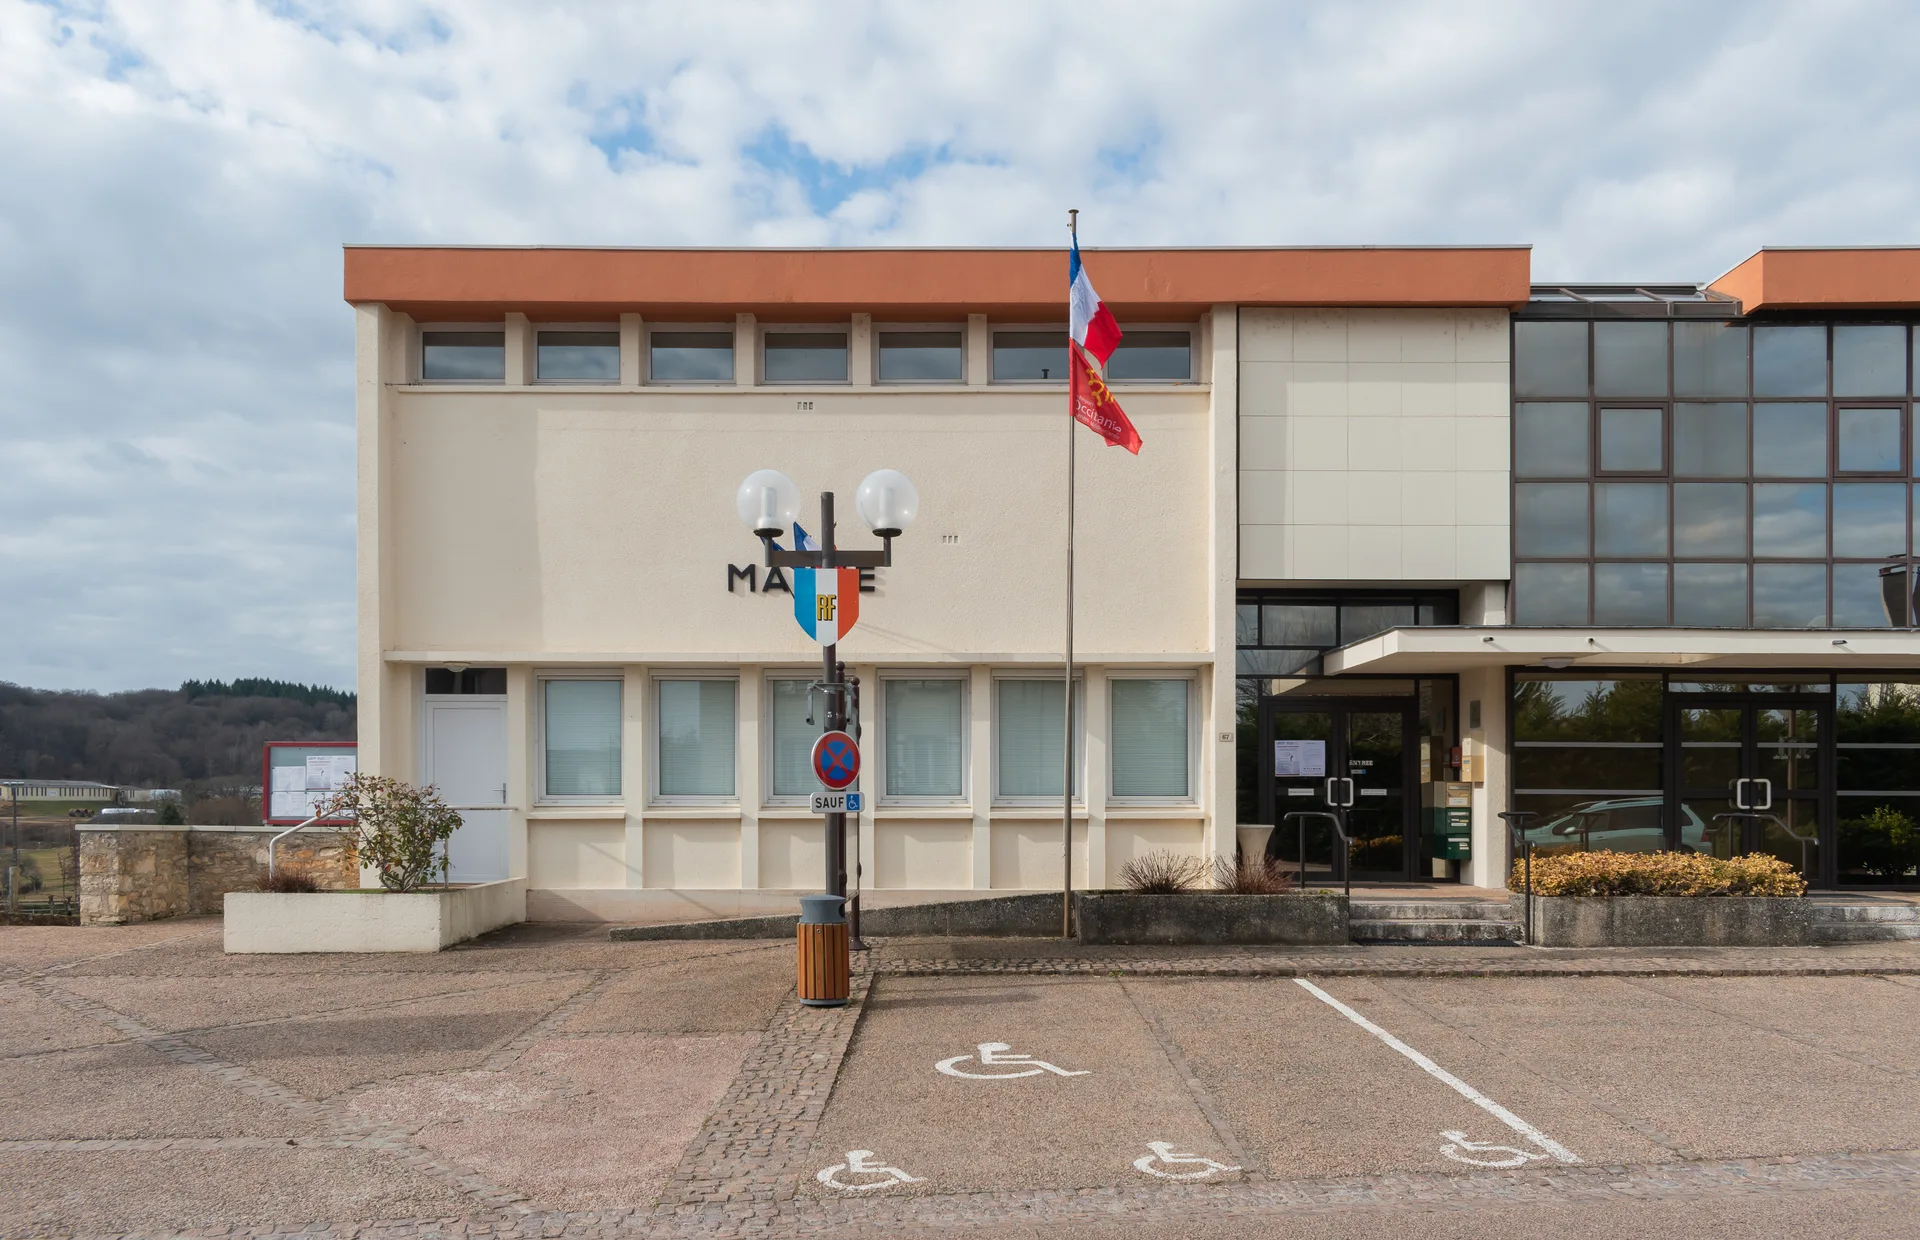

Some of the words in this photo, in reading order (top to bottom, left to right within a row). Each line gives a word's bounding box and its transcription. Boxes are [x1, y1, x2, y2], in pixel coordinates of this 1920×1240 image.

[727, 564, 875, 592] MAE
[817, 595, 836, 621] RF
[815, 797, 844, 808] SAUF
